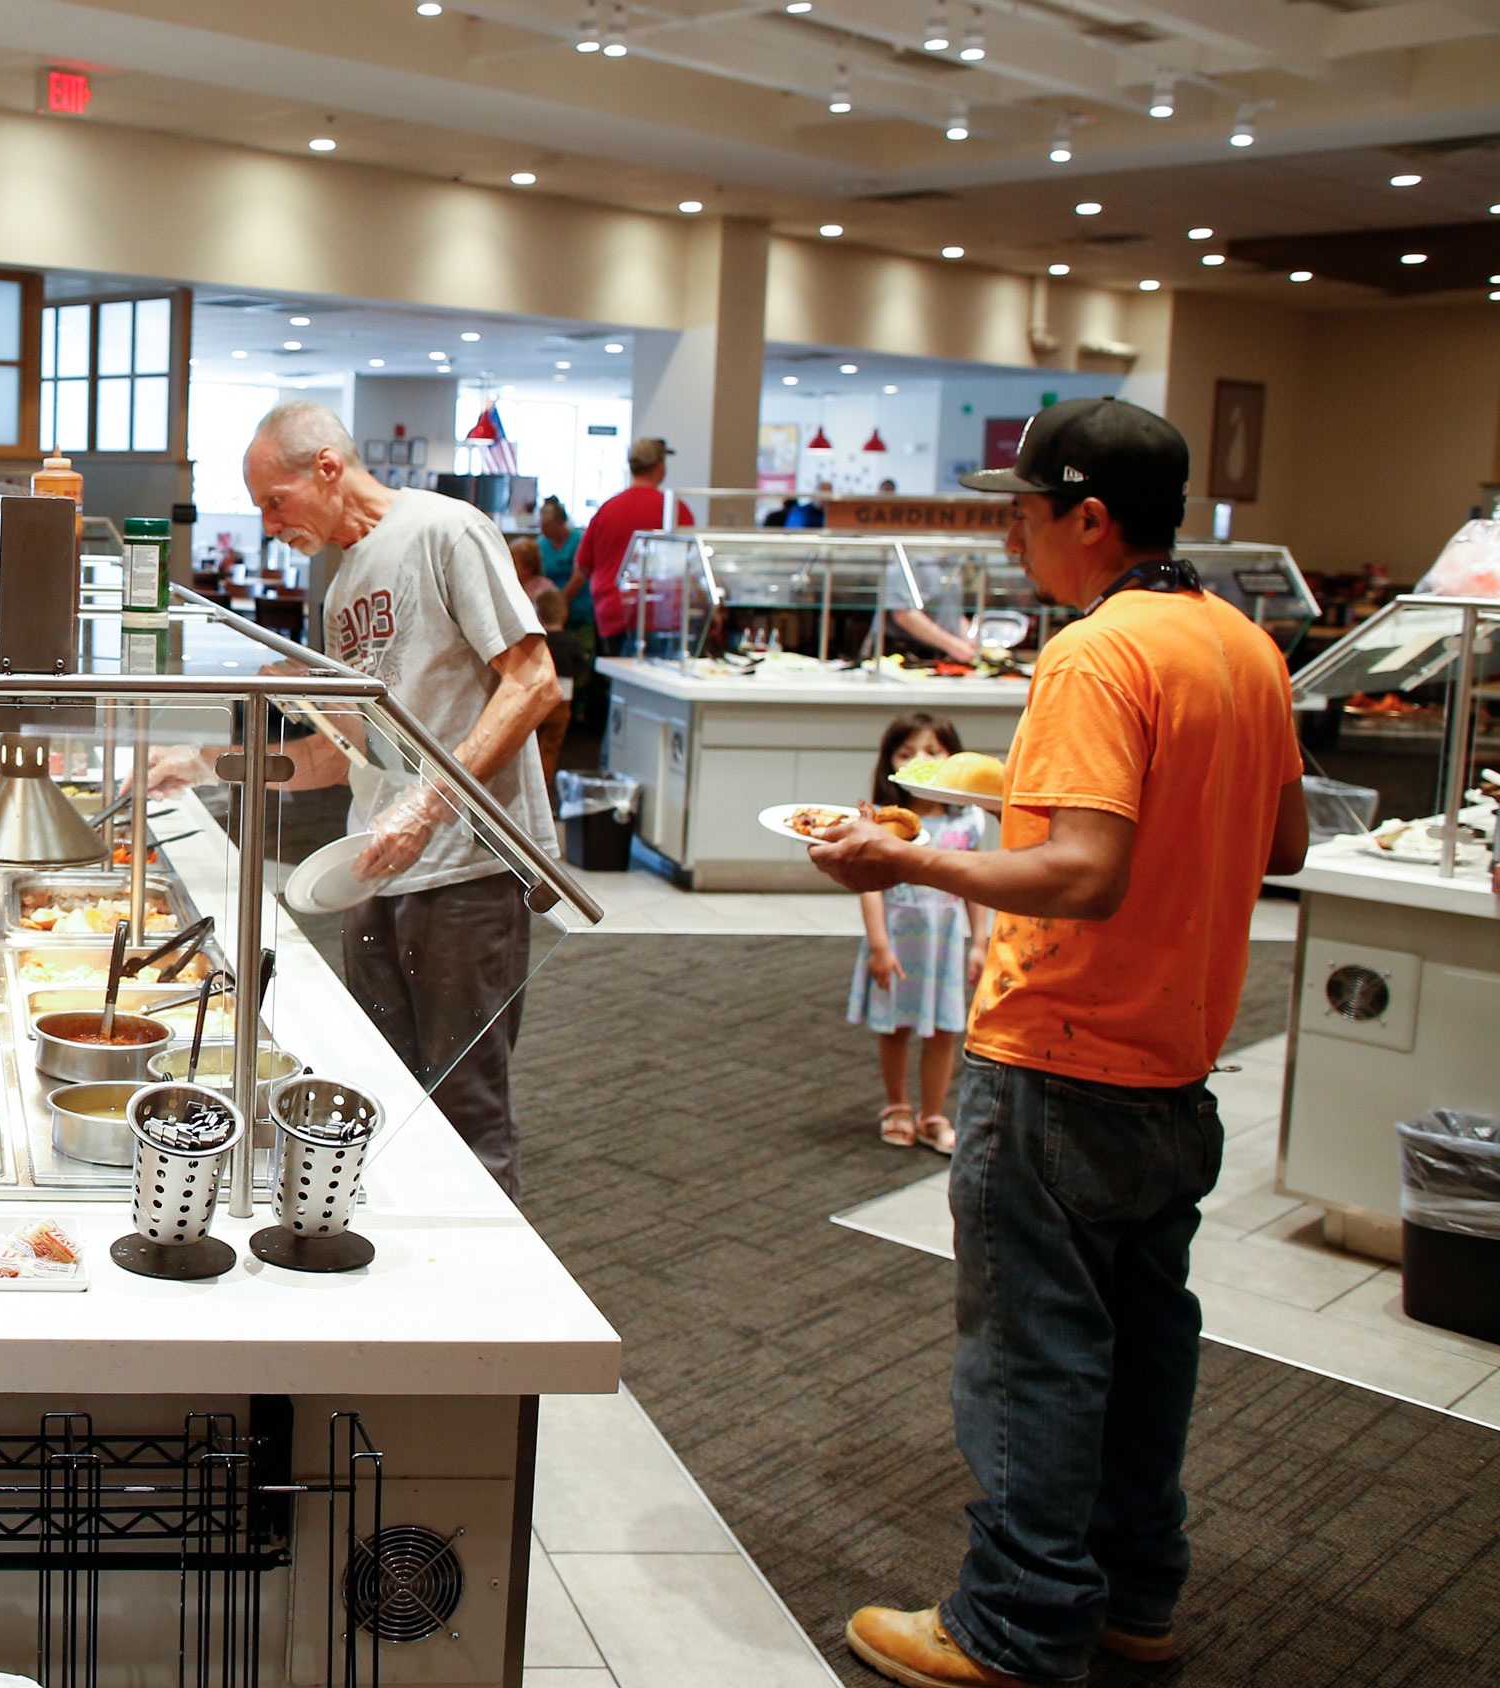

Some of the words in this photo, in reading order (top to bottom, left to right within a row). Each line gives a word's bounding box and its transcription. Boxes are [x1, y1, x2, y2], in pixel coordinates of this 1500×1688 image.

[49, 71, 88, 114] EXIT
[856, 506, 956, 525] GARDEN
[965, 507, 1012, 527] FRE
